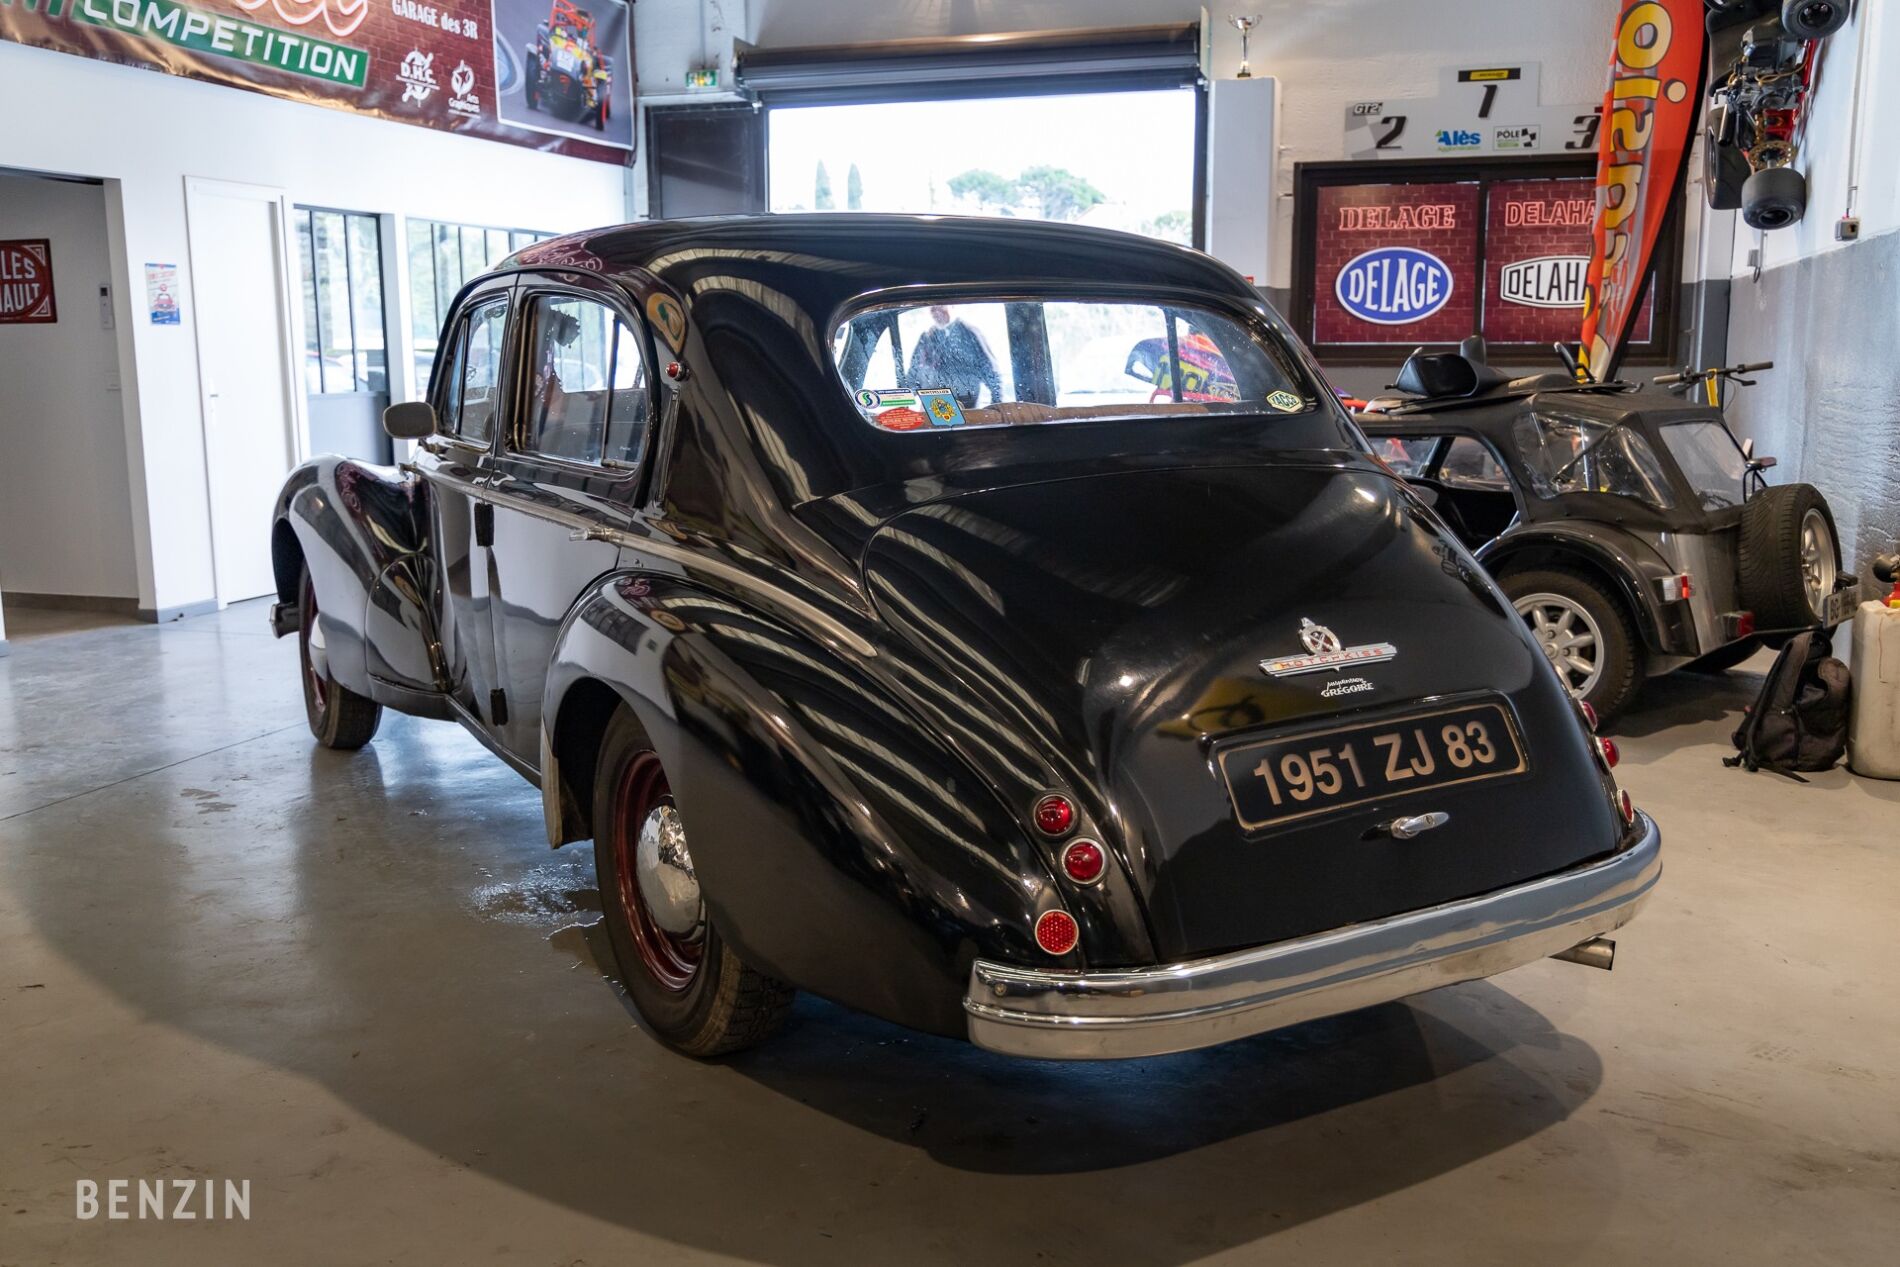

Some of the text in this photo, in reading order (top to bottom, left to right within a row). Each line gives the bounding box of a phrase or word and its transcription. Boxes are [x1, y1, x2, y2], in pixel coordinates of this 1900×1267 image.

[391, 0, 439, 28] GARAGE
[441, 12, 461, 34] des
[462, 19, 479, 40] 3R
[84, 0, 357, 81] COMPETITION
[1478, 84, 1498, 119] 1
[1375, 115, 1407, 149] 2
[1565, 115, 1602, 150] 3
[1339, 205, 1456, 231] DELAGE
[0, 283, 41, 313] AULT
[1349, 257, 1441, 313] DELAGE
[1280, 647, 1385, 670] HOTCHKISS
[1254, 720, 1497, 806] 1951 ZJ 83
